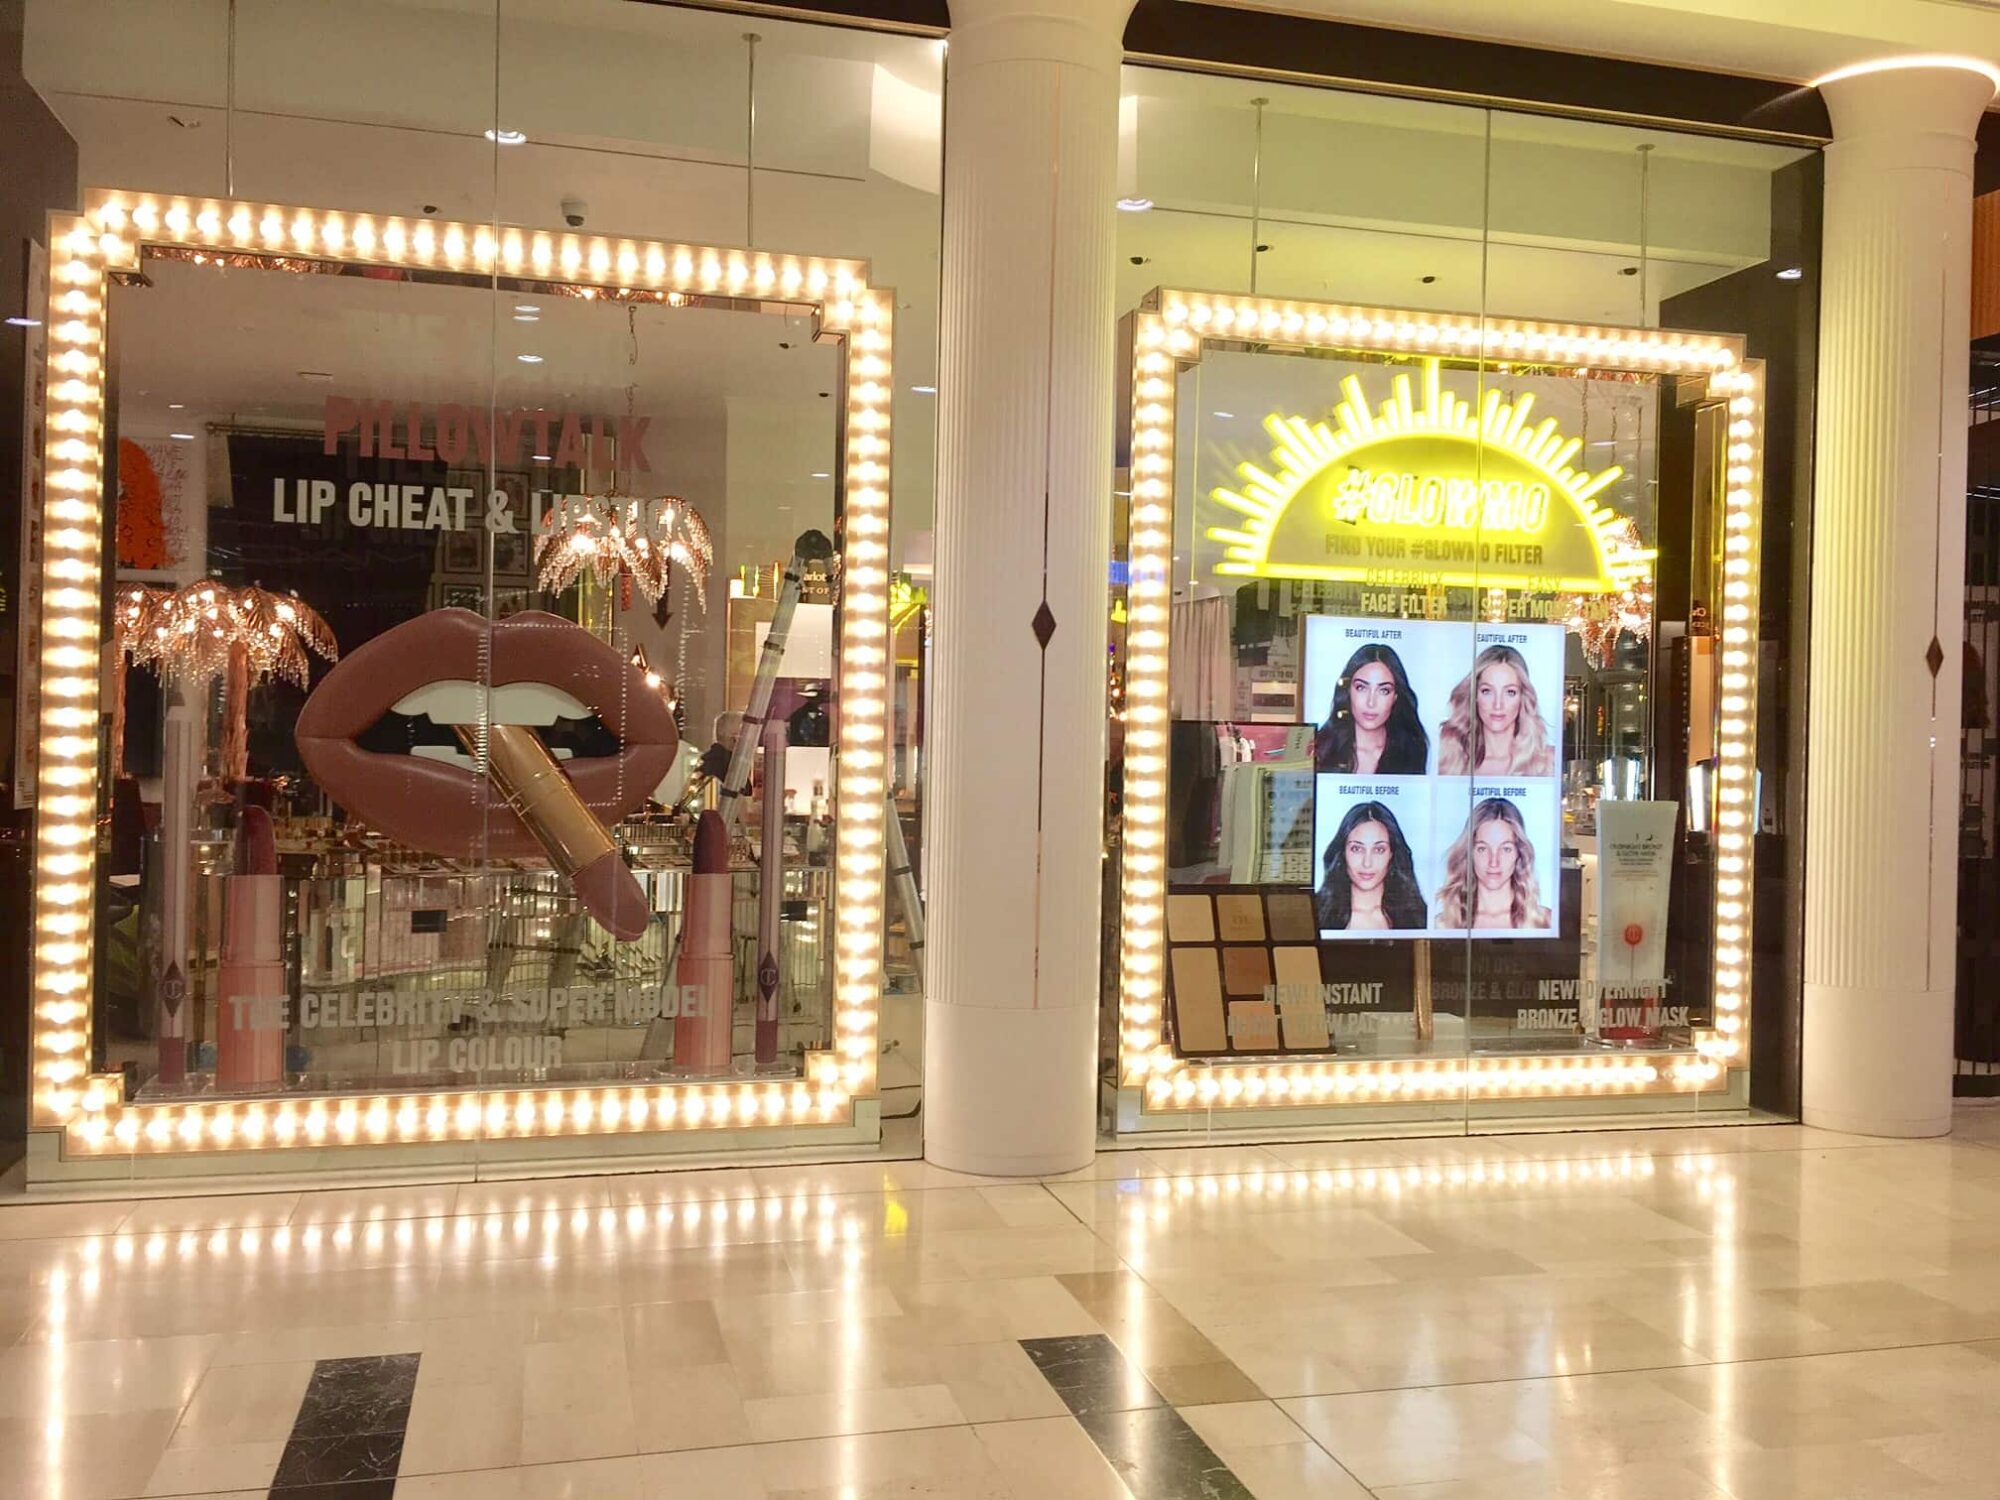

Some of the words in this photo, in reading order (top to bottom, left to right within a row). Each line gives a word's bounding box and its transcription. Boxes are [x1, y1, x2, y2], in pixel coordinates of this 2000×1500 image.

[324, 395, 652, 473] PILLOWTALK
[273, 477, 337, 525] LIP
[348, 480, 474, 532] CHEAT
[485, 489, 521, 535] &
[1325, 533, 1362, 556] FIND
[1365, 535, 1406, 559] YOUR
[1495, 543, 1543, 565] FILTER
[1360, 592, 1396, 613] FACE
[1401, 594, 1448, 616] FILTER
[1345, 628, 1380, 639] BEAUTIFUL
[1381, 629, 1402, 640] AFTER
[1473, 633, 1505, 643] EAUTIFUL
[1507, 634, 1528, 644] AFTER
[1339, 785, 1374, 795] BEAUTIFUL
[1375, 786, 1400, 796] BEFORE
[1503, 787, 1527, 797] BEFORE
[1318, 982, 1383, 1005] INSTANT
[1538, 979, 1581, 1001] NEW!
[300, 988, 464, 1029] CELEBRITY
[477, 985, 499, 1022] &
[507, 983, 606, 1023] SUPER
[1517, 1007, 1578, 1030] BRONZE
[1600, 1006, 1641, 1029] GLOW
[1646, 1005, 1690, 1029] MASK
[391, 1039, 441, 1075] LIP
[449, 1035, 563, 1072] COLOUR
